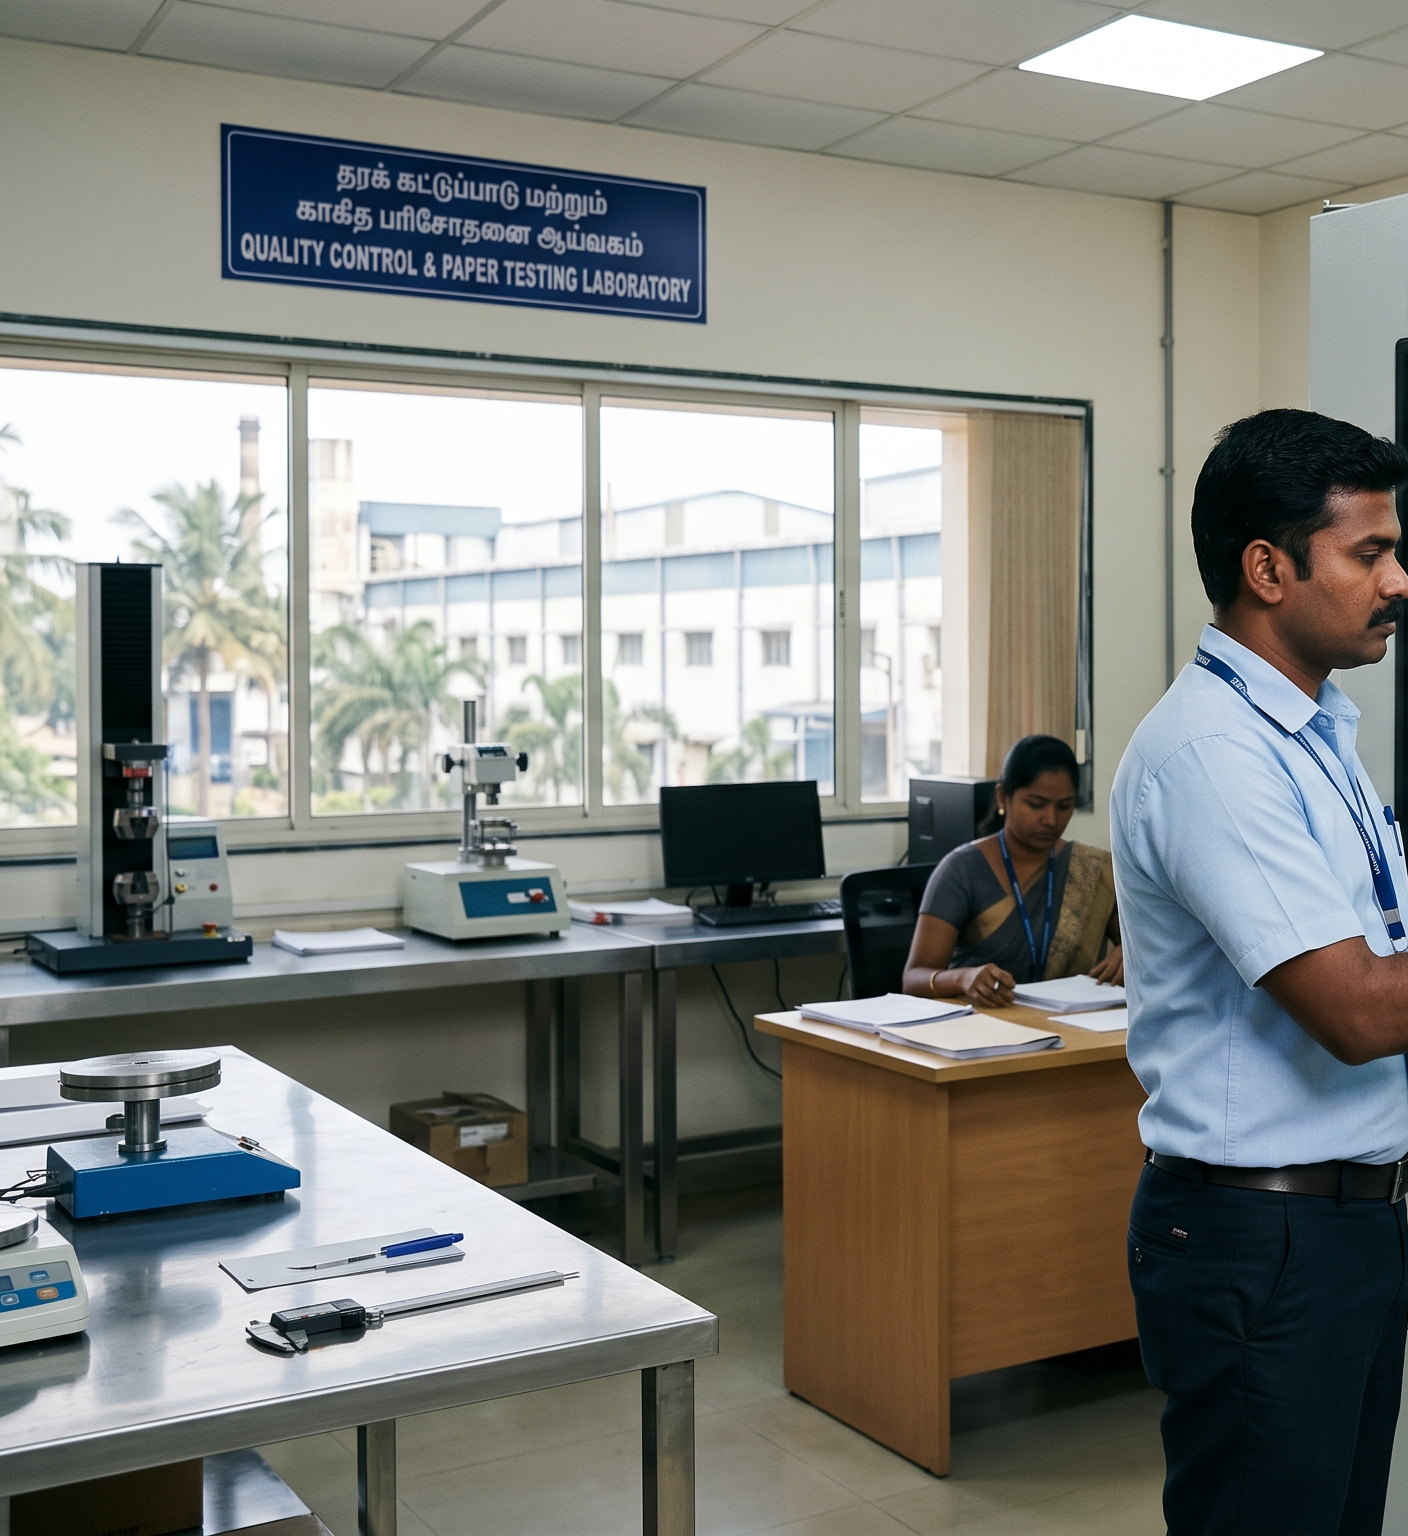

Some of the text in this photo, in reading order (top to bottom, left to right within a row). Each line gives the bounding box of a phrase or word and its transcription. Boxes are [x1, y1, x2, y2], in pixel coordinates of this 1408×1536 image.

[336, 162, 608, 220] தரக் கட்டுப்பாடு மற்றும்
[296, 200, 644, 257] காகித பரிசோதனை ஆய்வகம்
[240, 232, 692, 303] QUALITY CONTROL & PAPER TESTING LABORATORY
